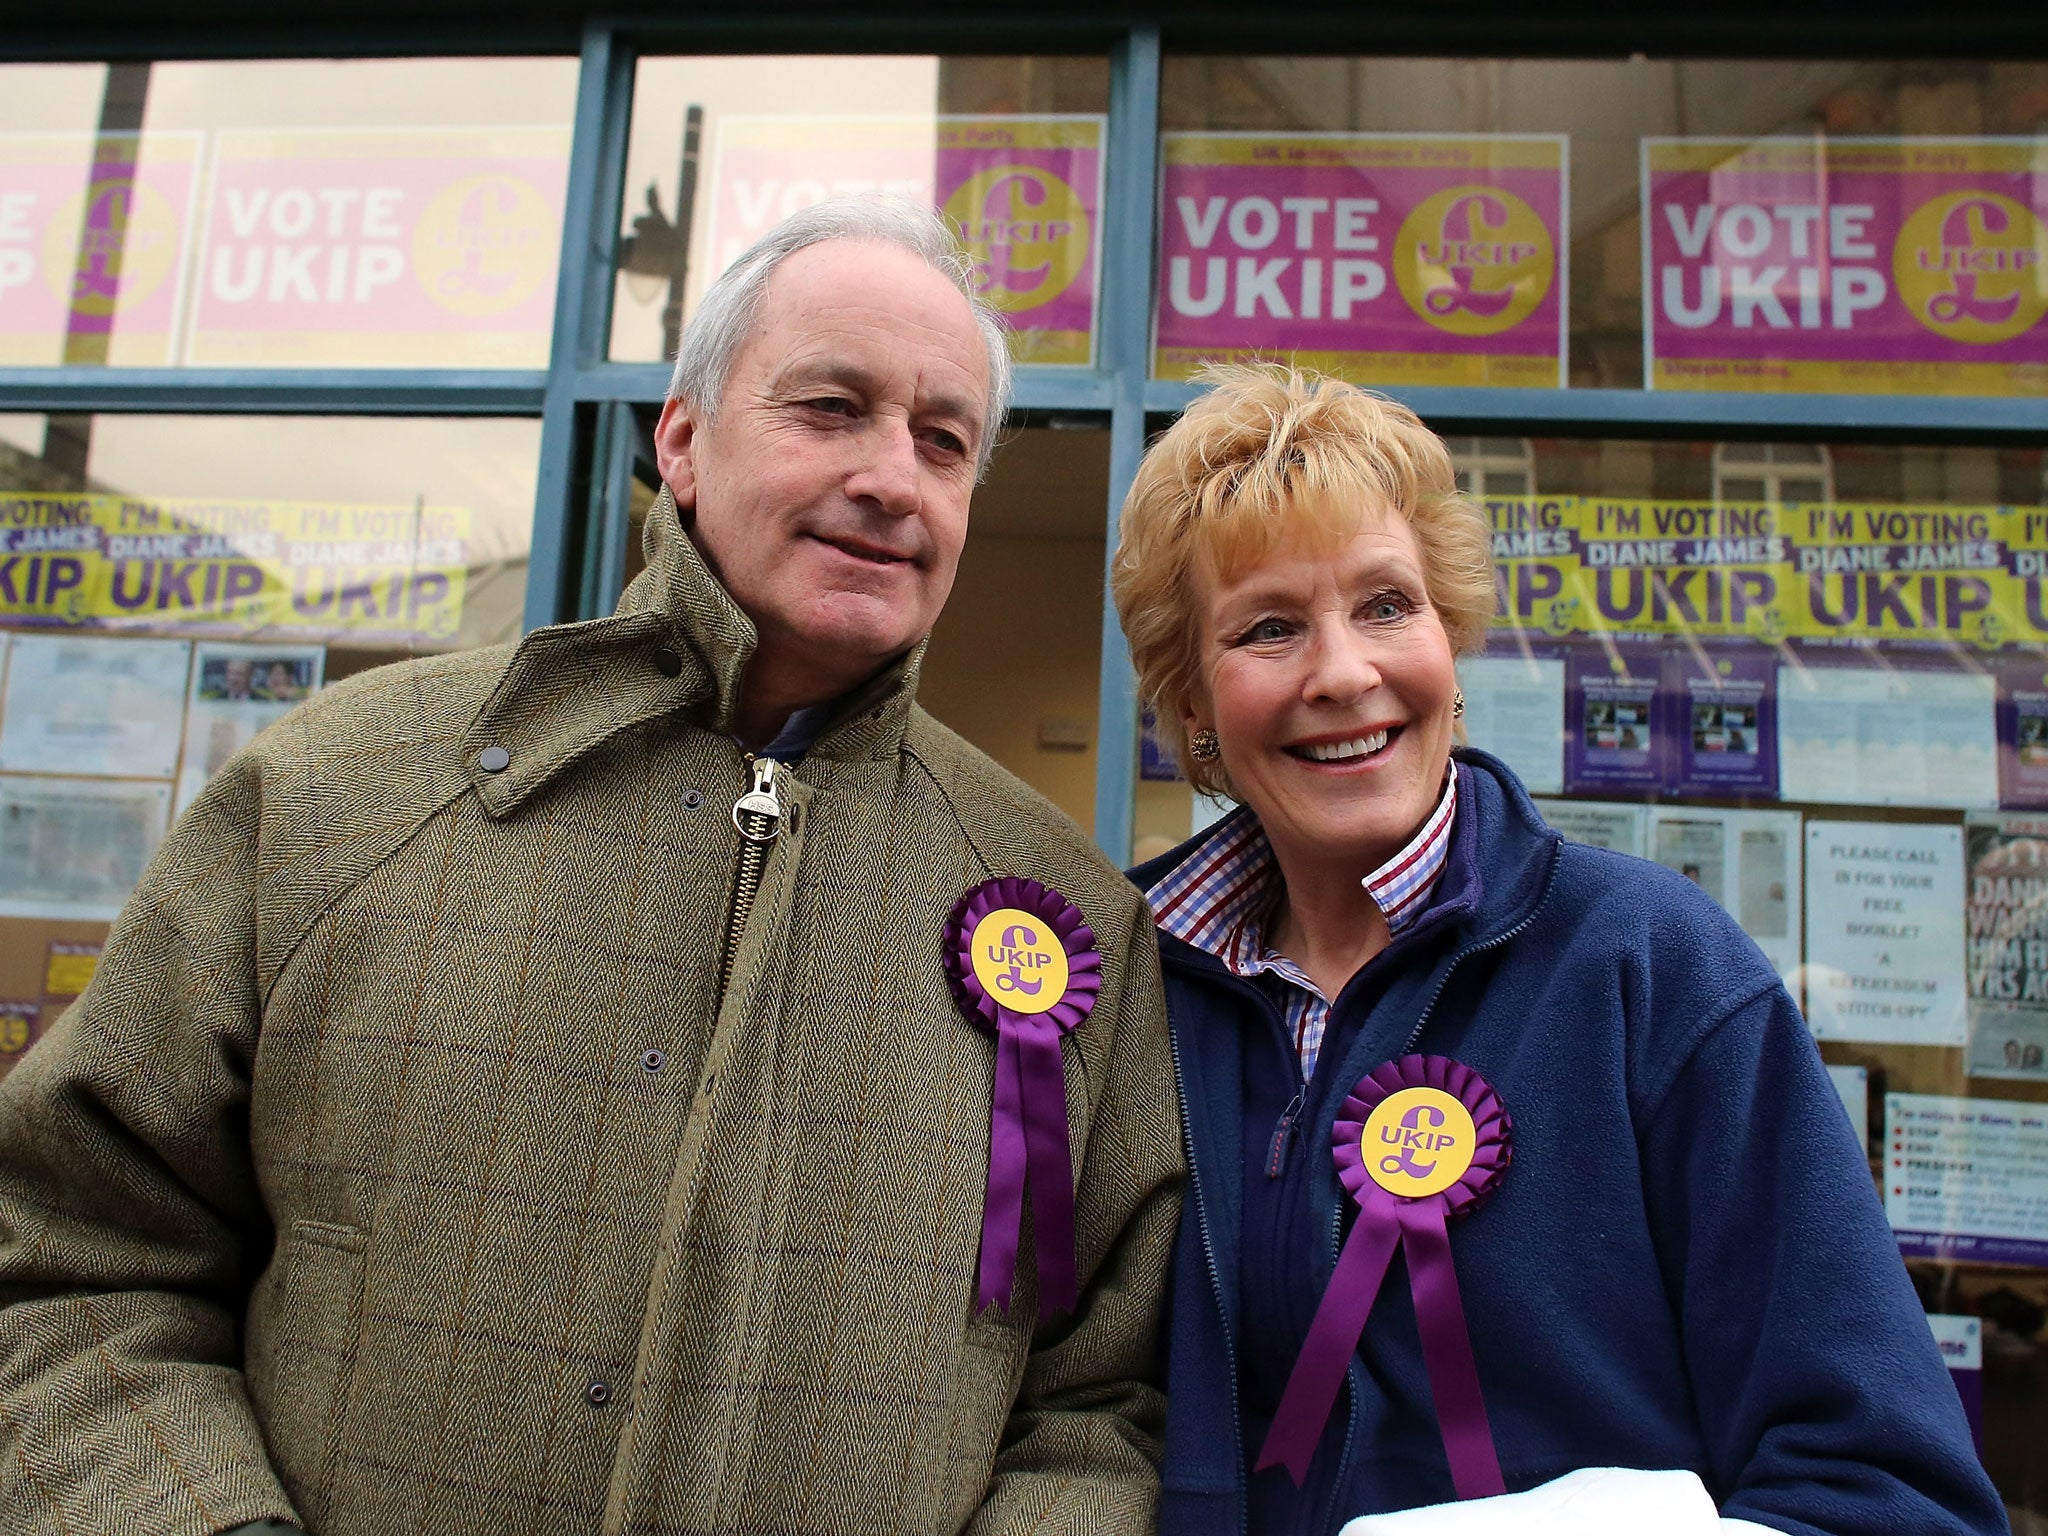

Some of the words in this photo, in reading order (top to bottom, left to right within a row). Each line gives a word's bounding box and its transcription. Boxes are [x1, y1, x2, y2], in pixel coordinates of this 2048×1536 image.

[225, 188, 404, 237] VOTE
[1177, 196, 1379, 251] VOTE
[1665, 204, 1877, 258] VOTE
[1418, 242, 1538, 265] UKIP
[213, 246, 404, 303] UKIP
[1169, 257, 1387, 320] UKIP
[1661, 266, 1887, 330] UKIP
[0, 499, 93, 526] OTING
[170, 506, 272, 533] VOTING
[1486, 502, 1562, 529] TING
[1597, 505, 1641, 534] I'M
[1653, 507, 1774, 538] VOTING
[1809, 510, 1853, 538] I'M
[1866, 513, 1989, 541] VOTING
[1492, 531, 1572, 556] AMES
[1588, 541, 1677, 566] DIANE
[1686, 537, 1785, 564] JAMES
[1800, 547, 1891, 572] DIANE
[1897, 542, 2000, 569] JAMES
[111, 560, 265, 612] UKIP
[293, 566, 449, 619] UKIP
[1596, 567, 1777, 625] UKIP
[1810, 573, 1991, 629] UKIP
[1863, 898, 1904, 913] FREE
[988, 945, 1052, 969] UKIP
[1381, 1125, 1455, 1151] UKIP
